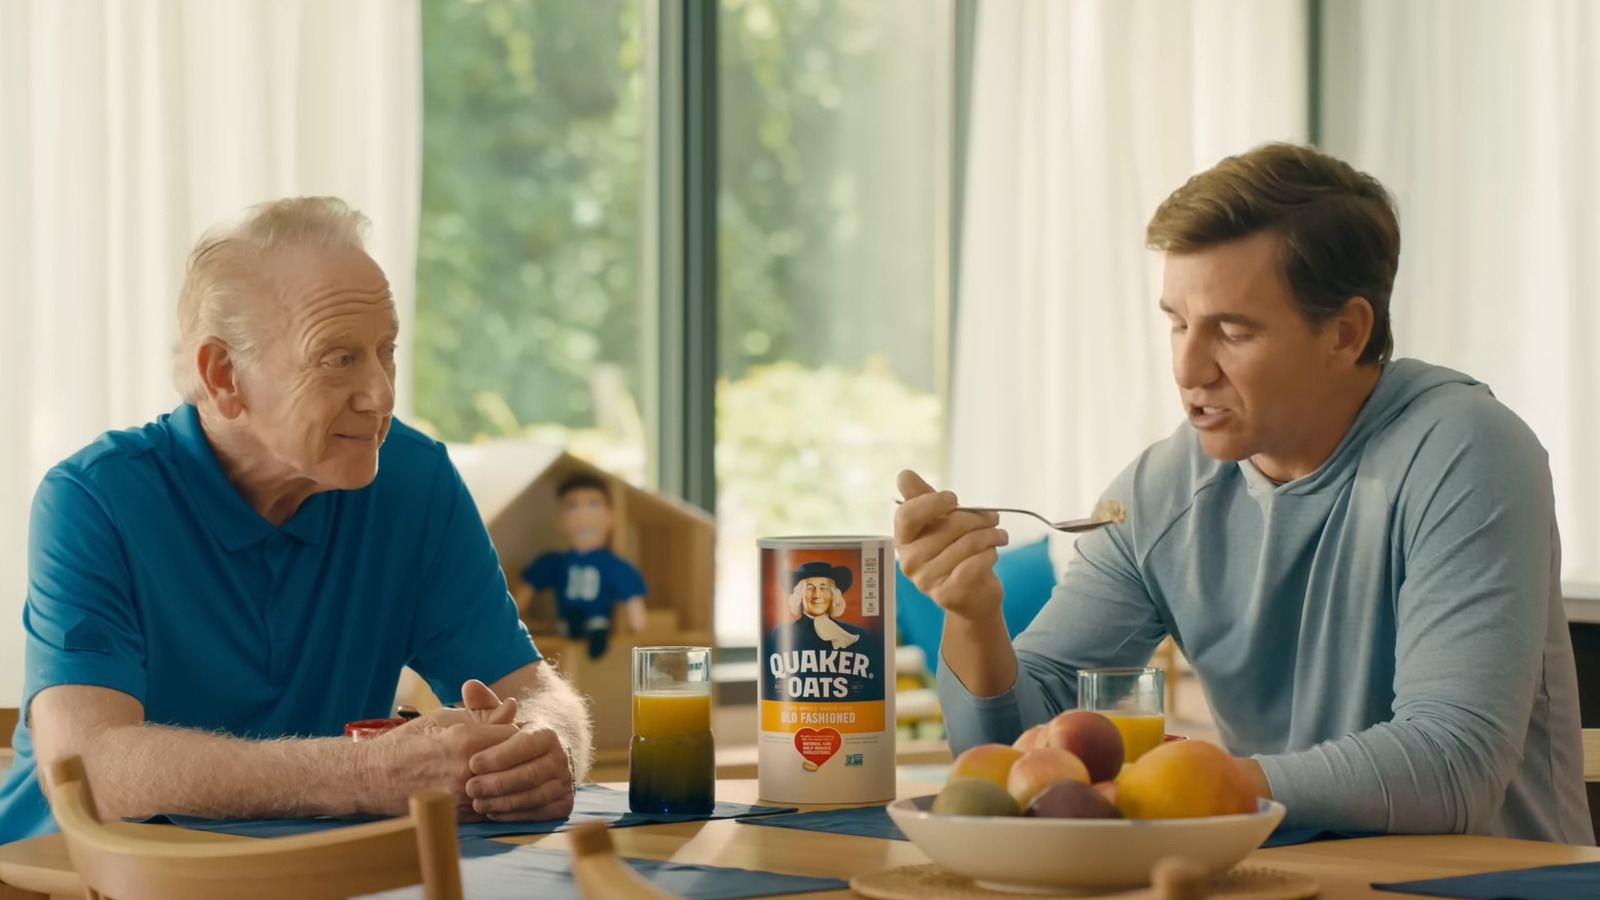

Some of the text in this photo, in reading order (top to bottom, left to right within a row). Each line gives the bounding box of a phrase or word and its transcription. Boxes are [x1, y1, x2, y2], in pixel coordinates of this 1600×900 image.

[770, 650, 869, 679] QUAKER
[788, 677, 848, 698] OATS
[781, 712, 856, 724] OLD FASHIONED
